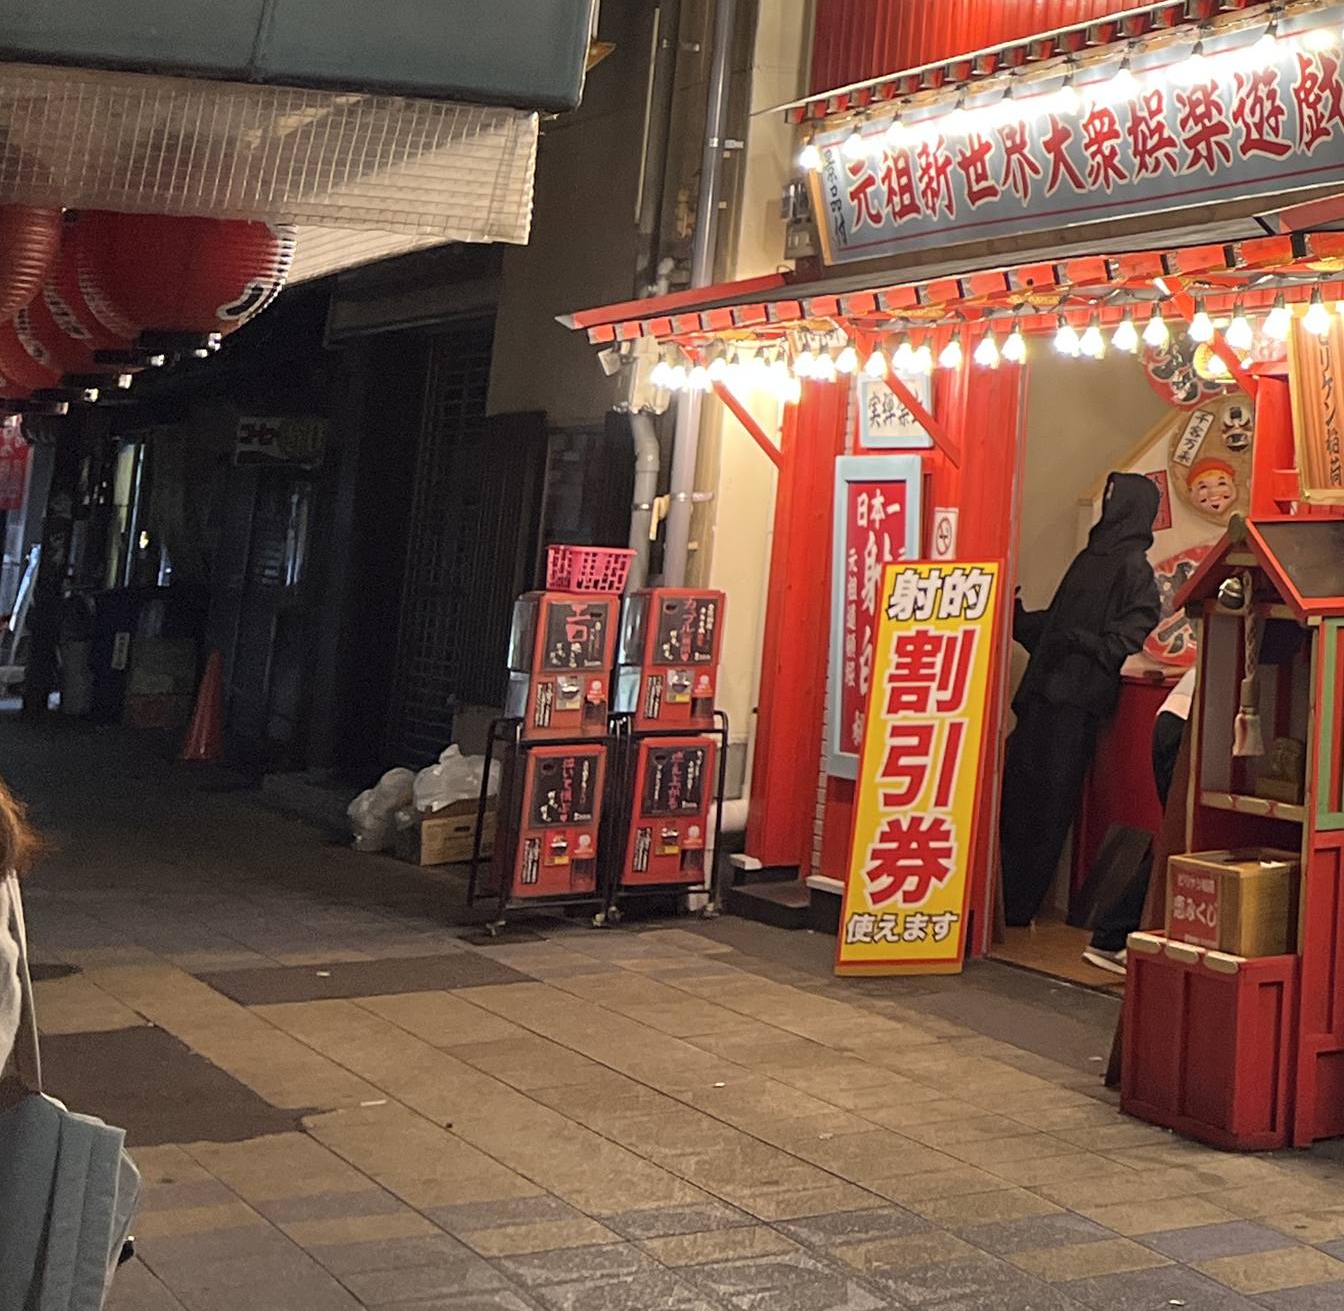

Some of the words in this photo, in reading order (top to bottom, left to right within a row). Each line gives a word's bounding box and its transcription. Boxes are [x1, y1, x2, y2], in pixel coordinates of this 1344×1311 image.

[856, 488, 902, 530] 日本一
[886, 566, 996, 623] 射的
[864, 623, 979, 910] 割引券
[844, 910, 961, 946] 使えます
